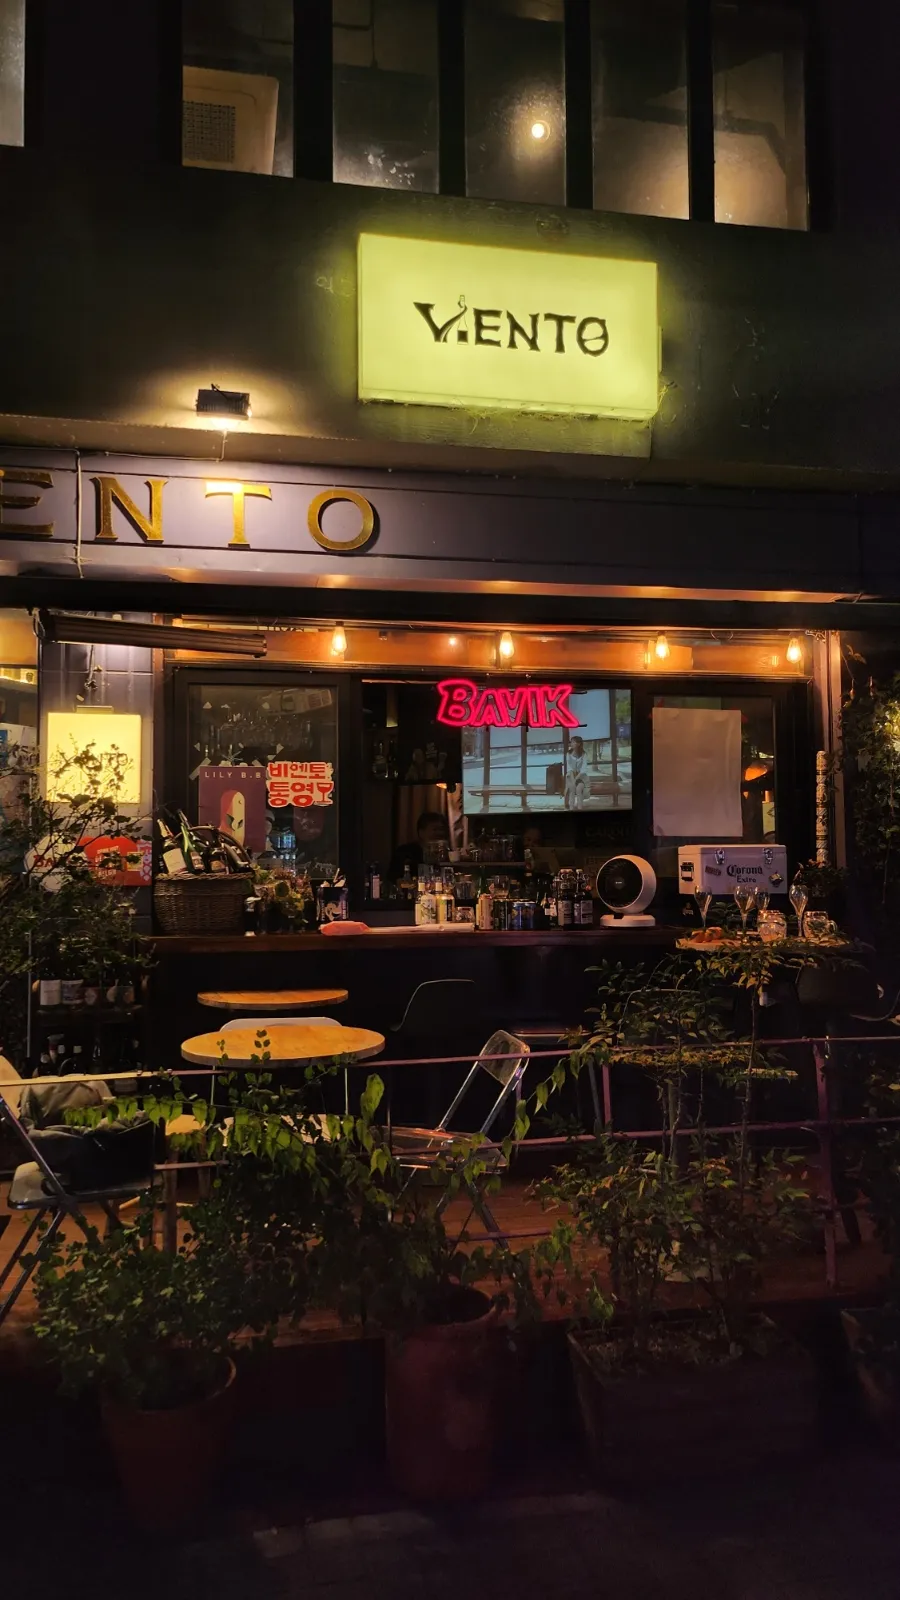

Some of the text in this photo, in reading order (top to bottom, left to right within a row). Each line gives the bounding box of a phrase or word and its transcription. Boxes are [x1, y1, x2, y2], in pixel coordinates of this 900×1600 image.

[413, 295, 609, 357] VIENTO
[437, 679, 580, 727] BAVIK
[269, 763, 326, 779] 비엔토
[269, 782, 314, 807] 통영
[726, 864, 763, 877] Corona
